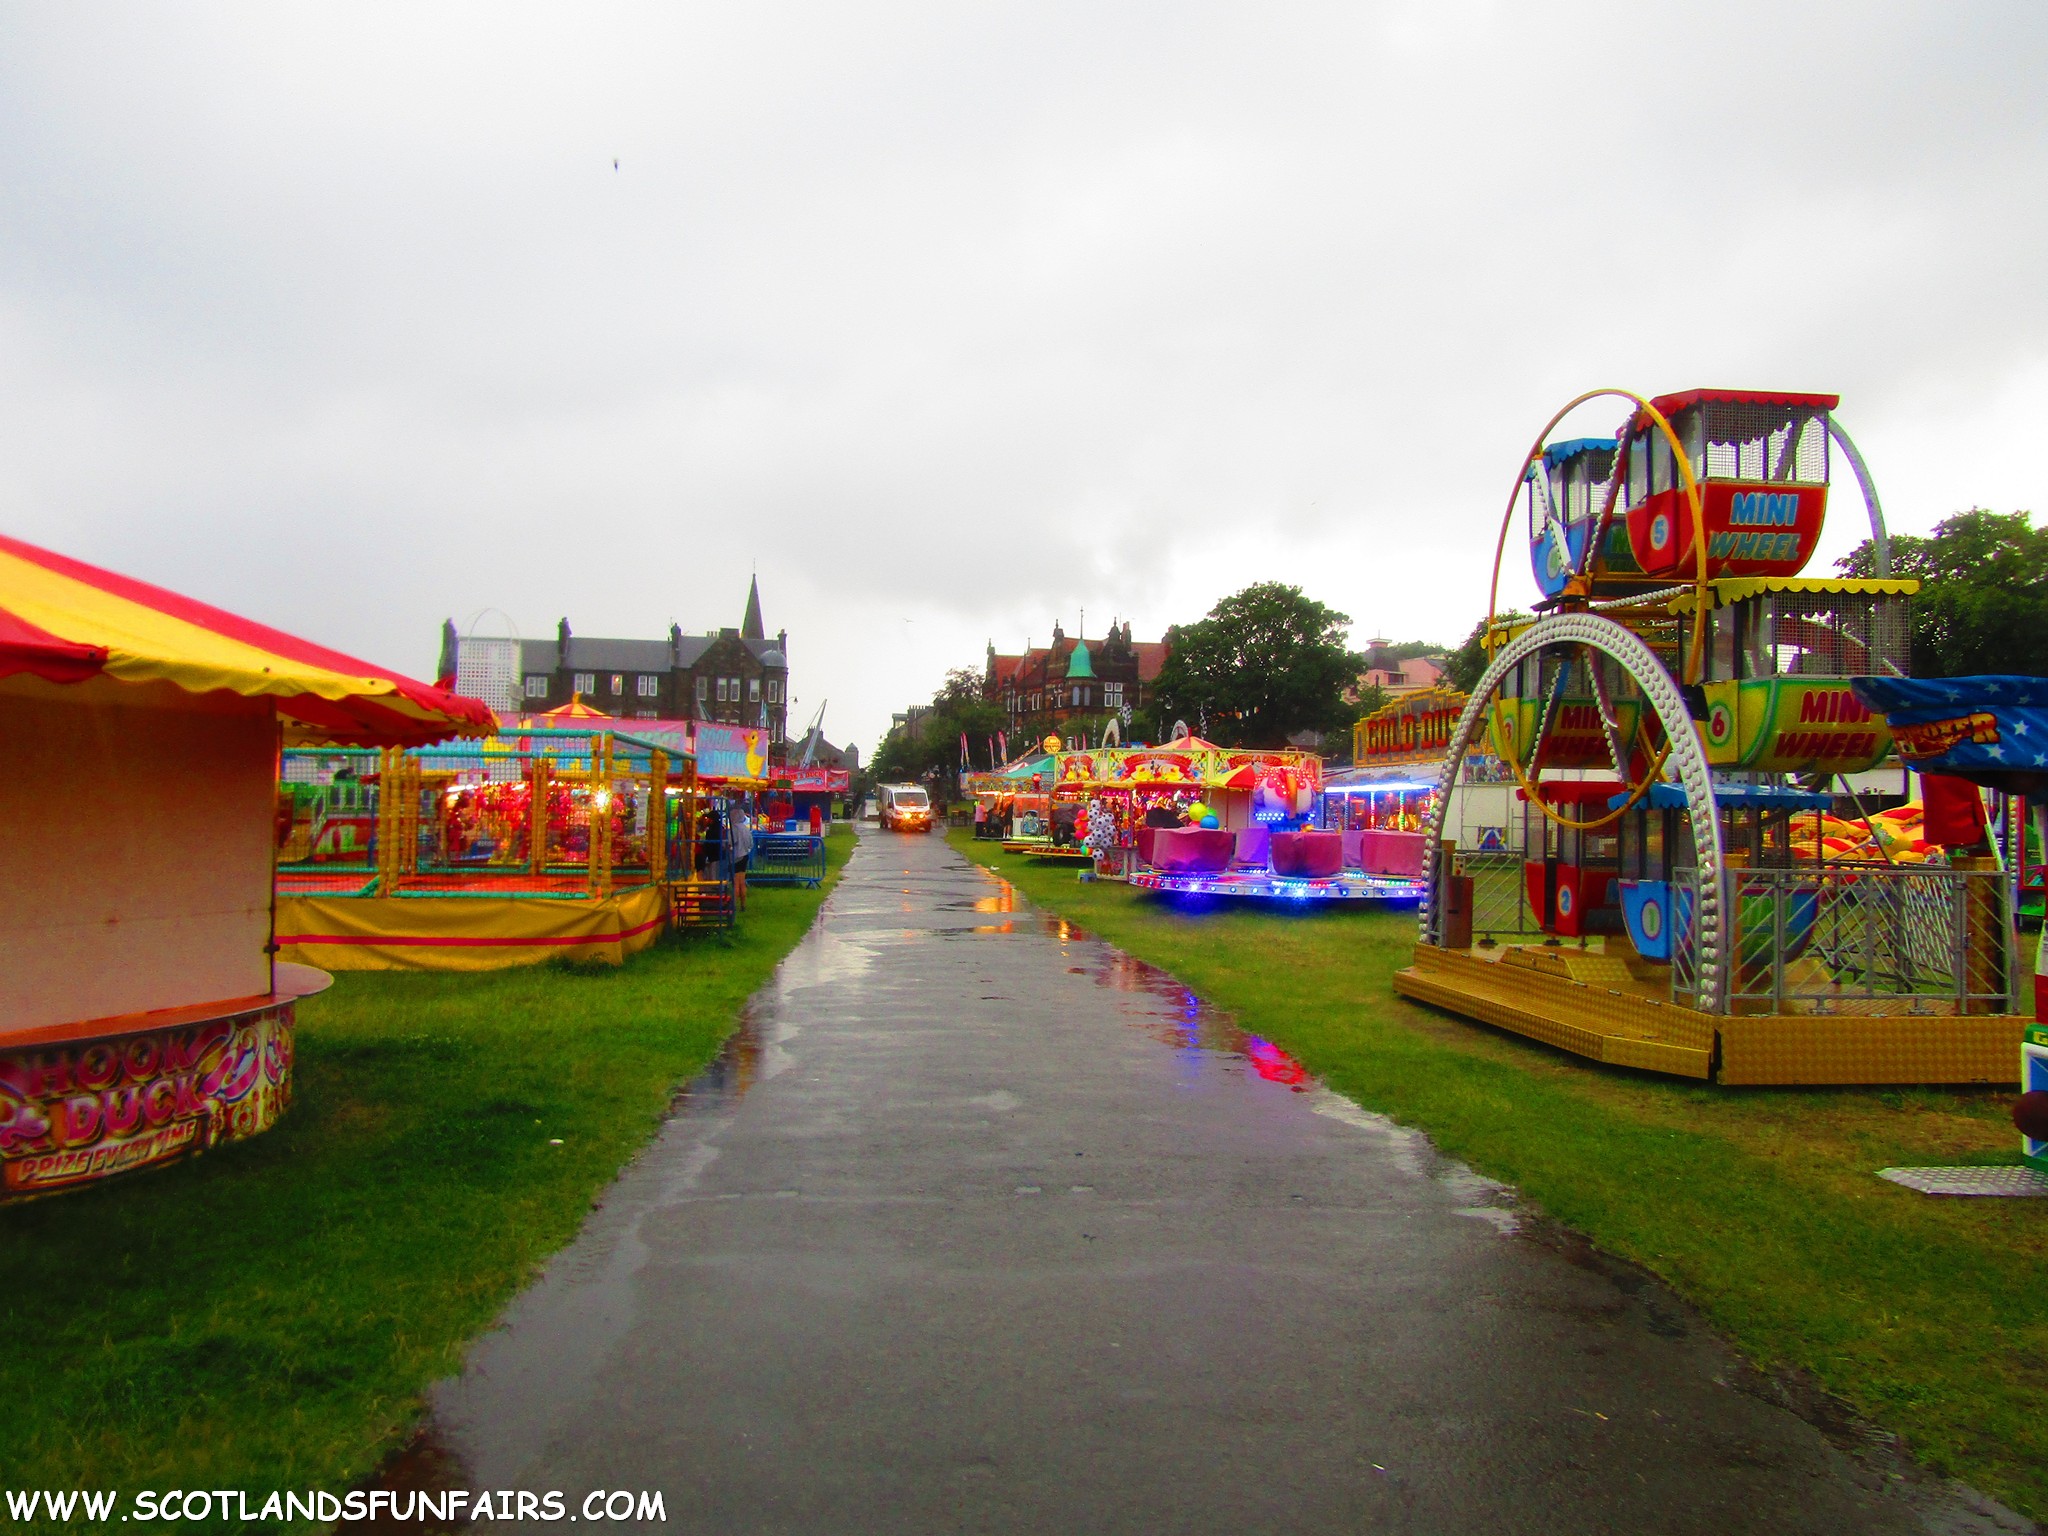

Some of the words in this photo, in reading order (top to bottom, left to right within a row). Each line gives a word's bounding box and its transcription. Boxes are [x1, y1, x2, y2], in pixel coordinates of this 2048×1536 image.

[1729, 492, 1800, 526] MINI
[1654, 518, 1665, 543] 5
[1708, 531, 1800, 561] WHEEL
[1561, 705, 1612, 730] MIN
[1710, 711, 1725, 738] 6
[1773, 731, 1878, 760] WHEEL
[1560, 888, 1571, 909] 2
[1650, 906, 1656, 932] 1
[25, 1032, 197, 1100] HOOK
[63, 1073, 209, 1149] DUCK
[18, 1151, 89, 1182] PRIZE
[90, 1137, 151, 1174] EVERY
[151, 1119, 197, 1156] TIME
